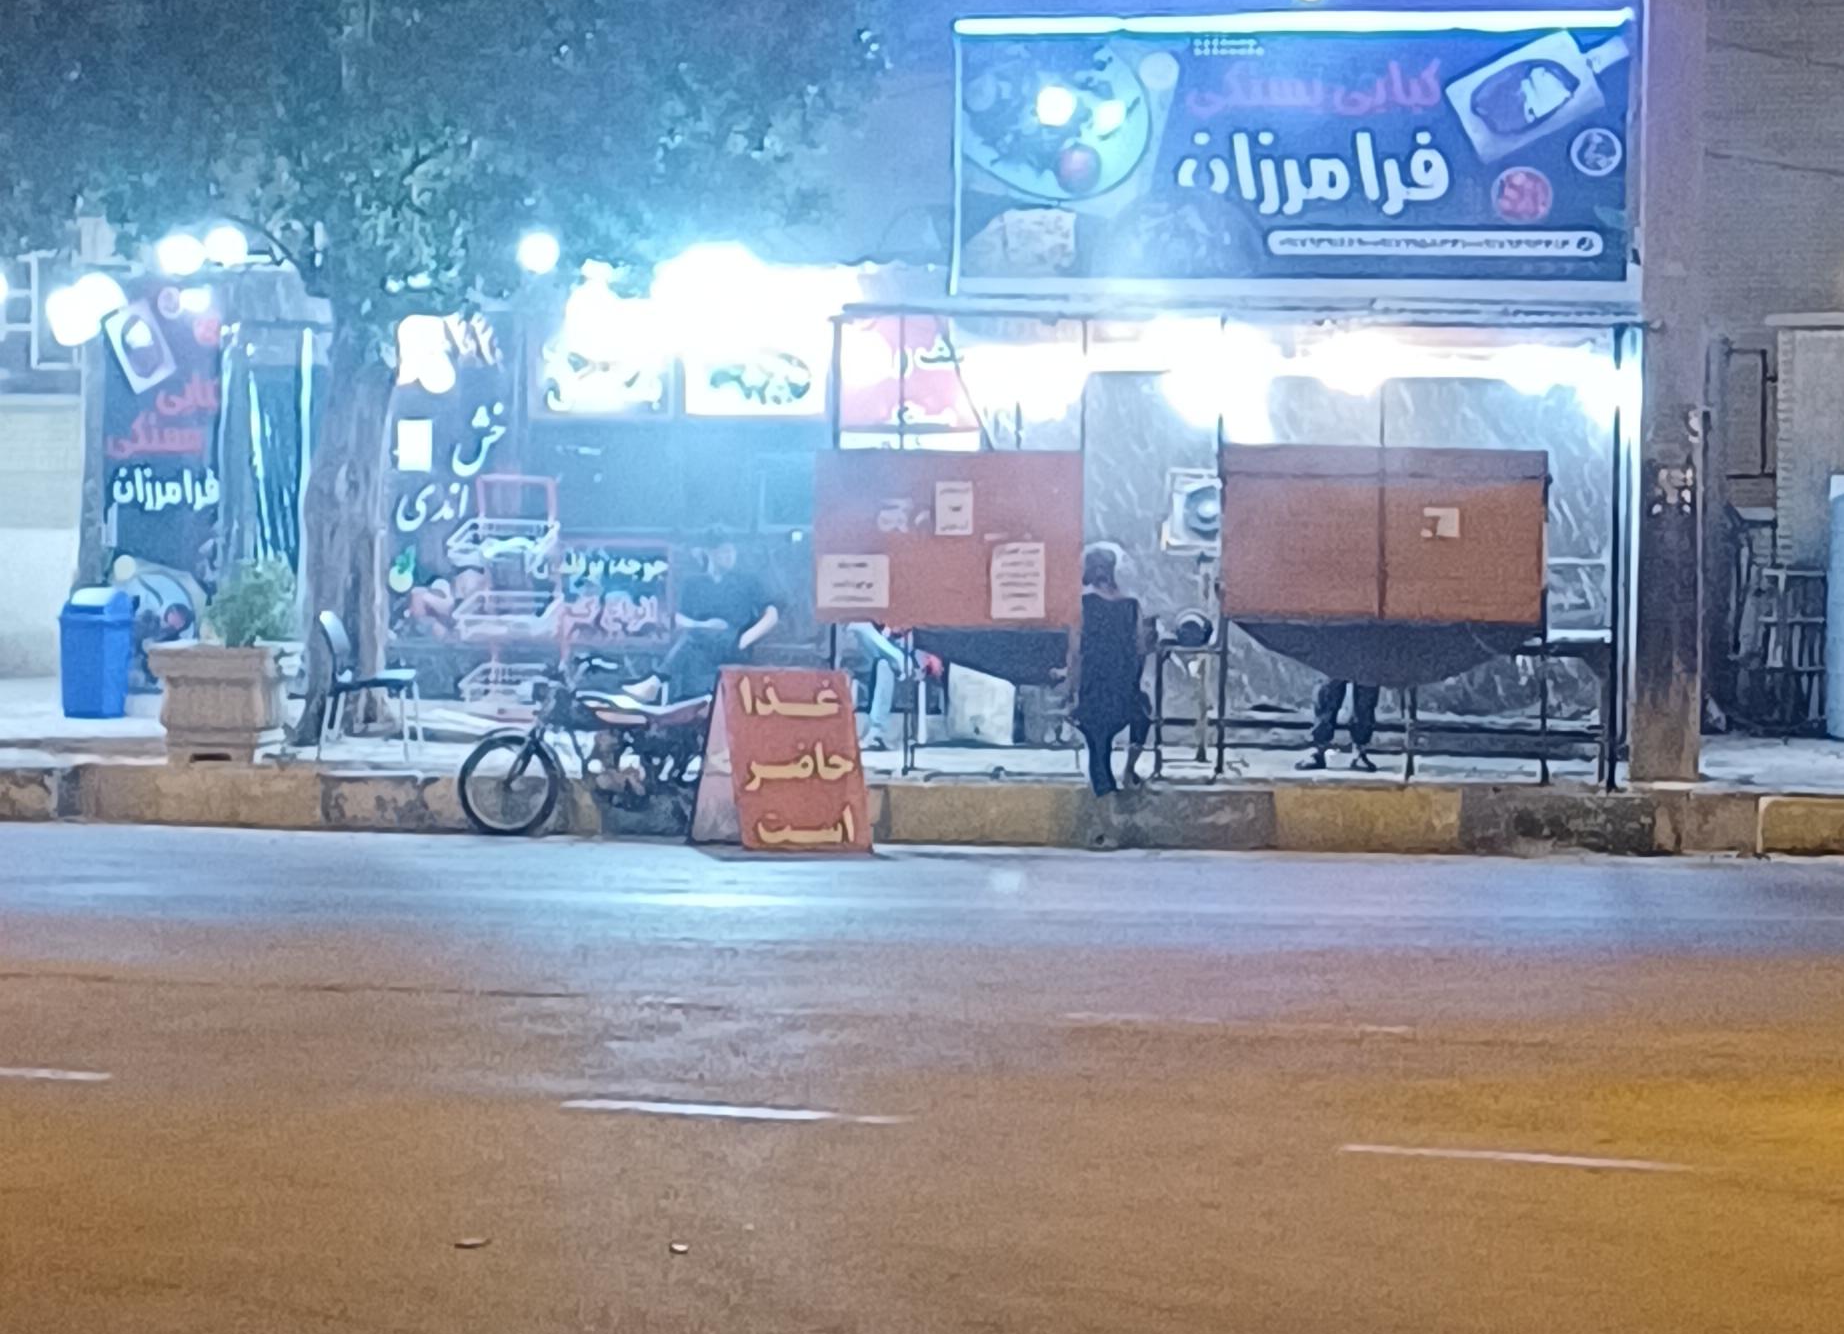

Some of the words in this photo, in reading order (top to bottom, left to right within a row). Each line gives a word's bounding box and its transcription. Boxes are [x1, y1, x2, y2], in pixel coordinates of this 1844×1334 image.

[1332, 58, 1441, 116] کبابی
[1177, 131, 1450, 215] فرامرزان
[113, 466, 220, 511] فرامرزان
[739, 675, 840, 716] غذا
[745, 741, 855, 791] حاضر
[757, 804, 855, 844] است
